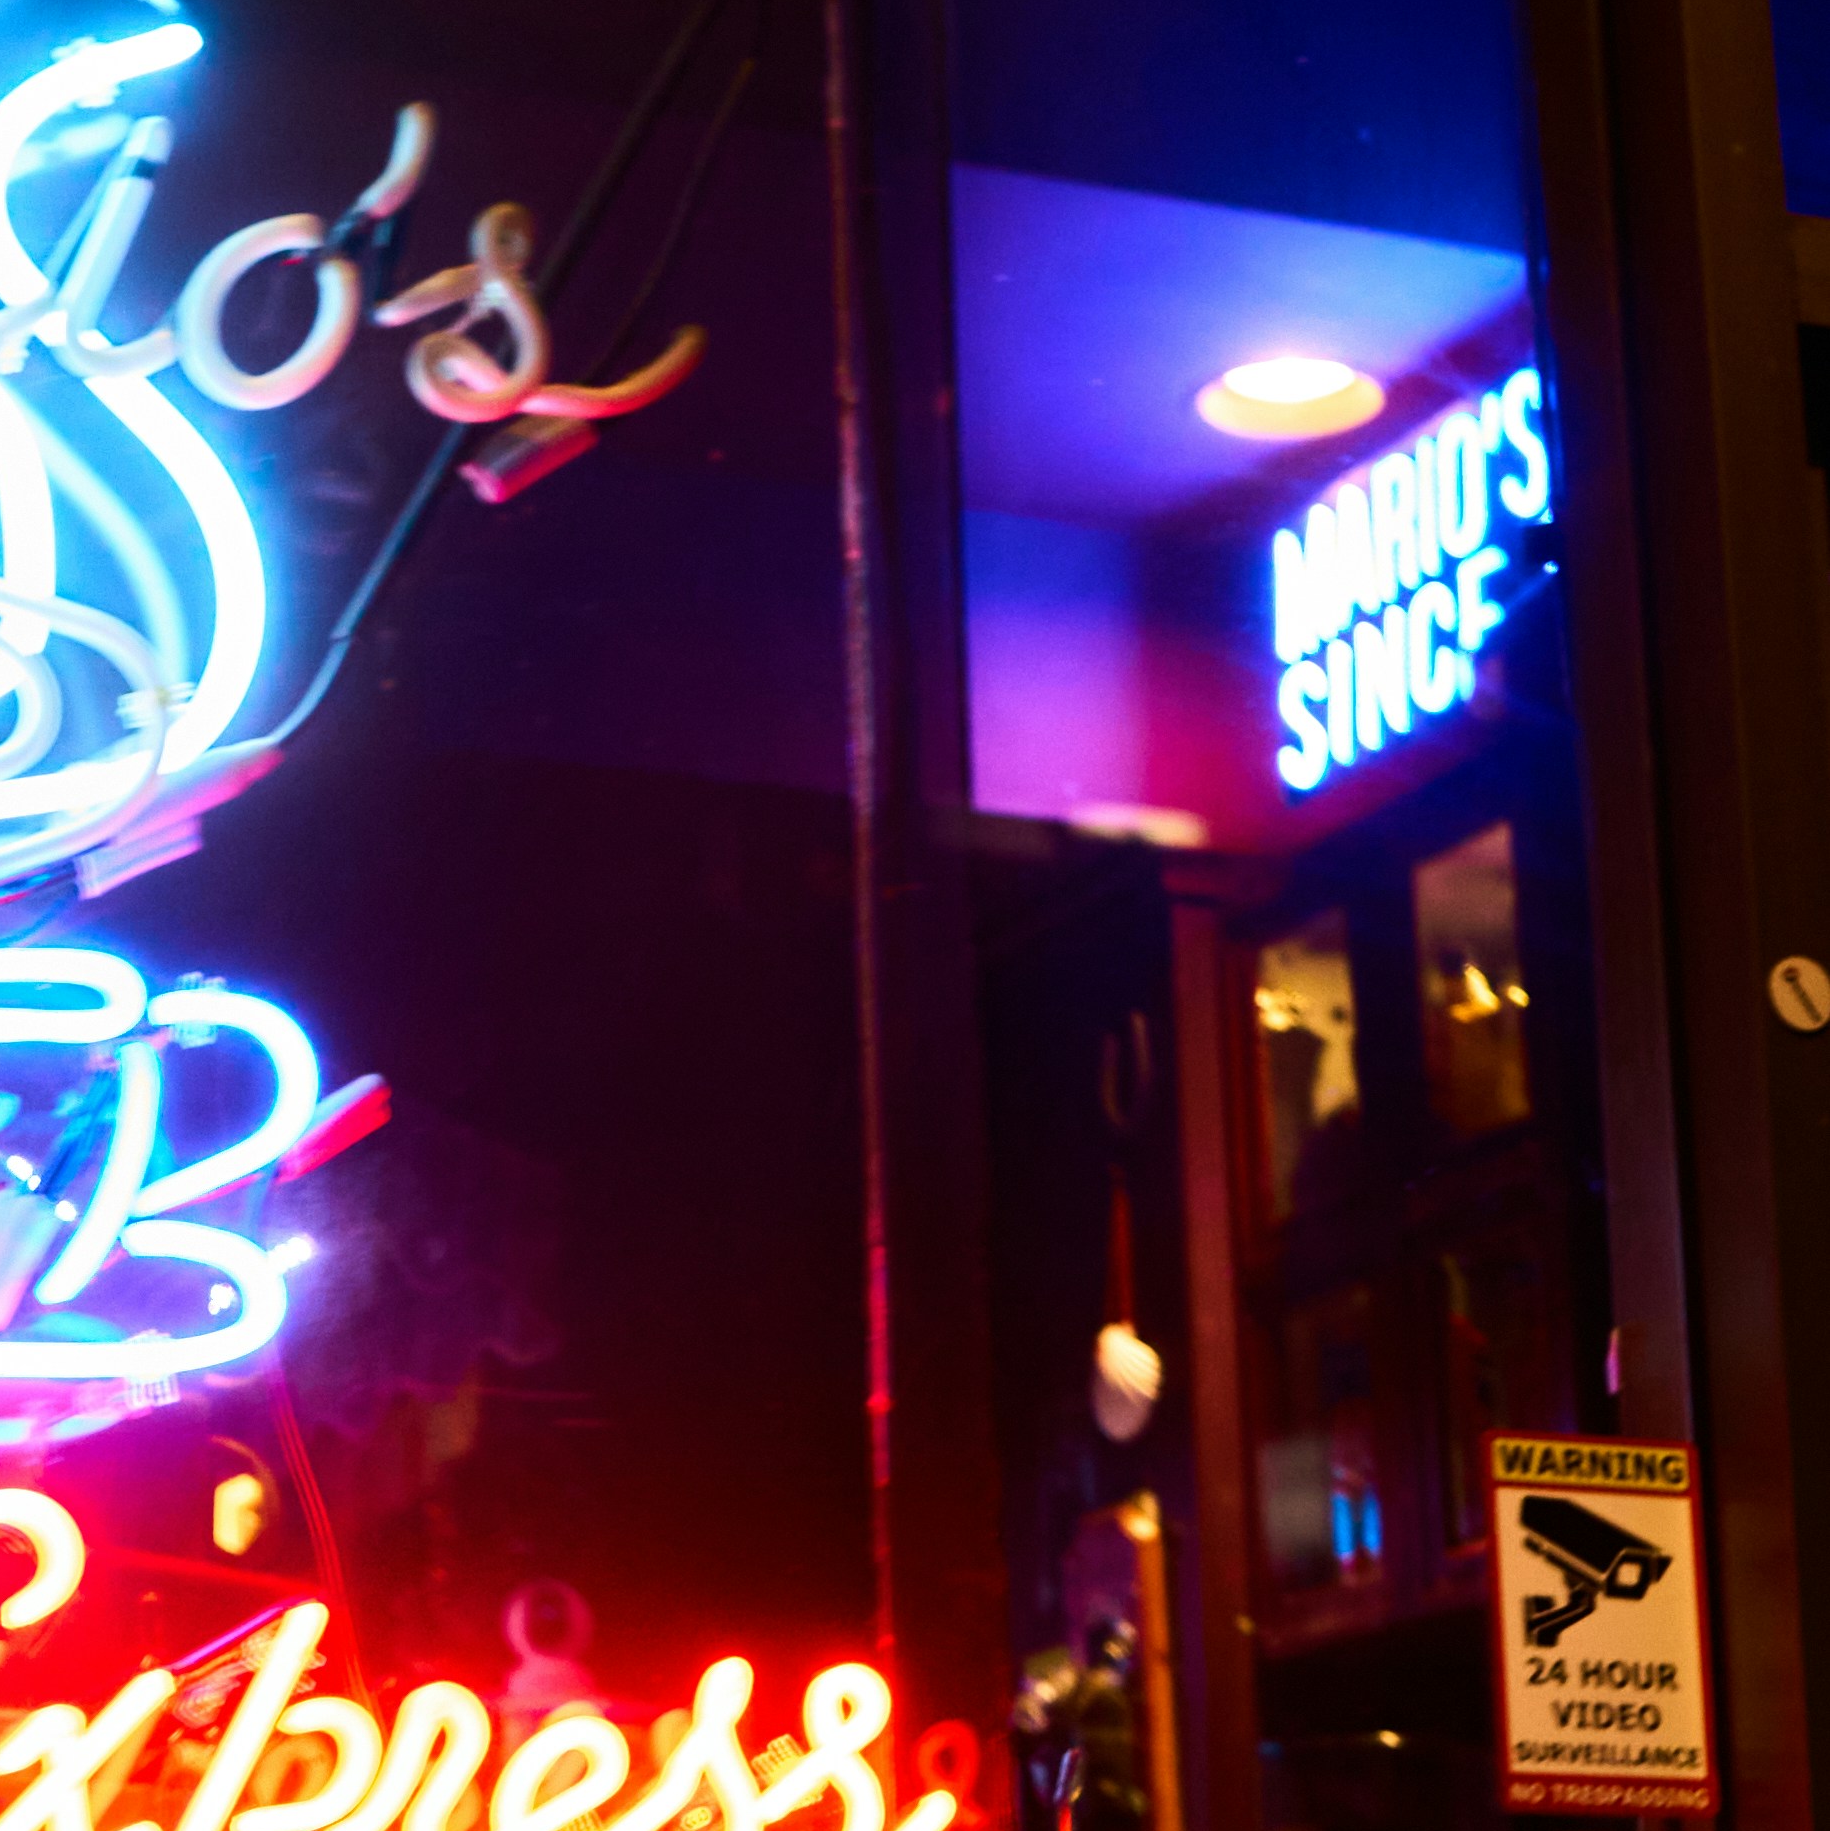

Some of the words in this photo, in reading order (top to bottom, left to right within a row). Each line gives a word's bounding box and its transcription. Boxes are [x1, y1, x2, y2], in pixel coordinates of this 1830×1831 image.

[1273, 368, 1551, 665] MARIO'S
[1498, 1443, 1685, 1485] WARNING
[1525, 1657, 1567, 1686] 24
[1580, 1660, 1679, 1691] HOUR
[1552, 1700, 1663, 1731] VIDEO
[1515, 1740, 1703, 1770] SURVEILLANCE
[1508, 1781, 1544, 1804] NO
[1552, 1783, 1710, 1810] TRESPASSING
